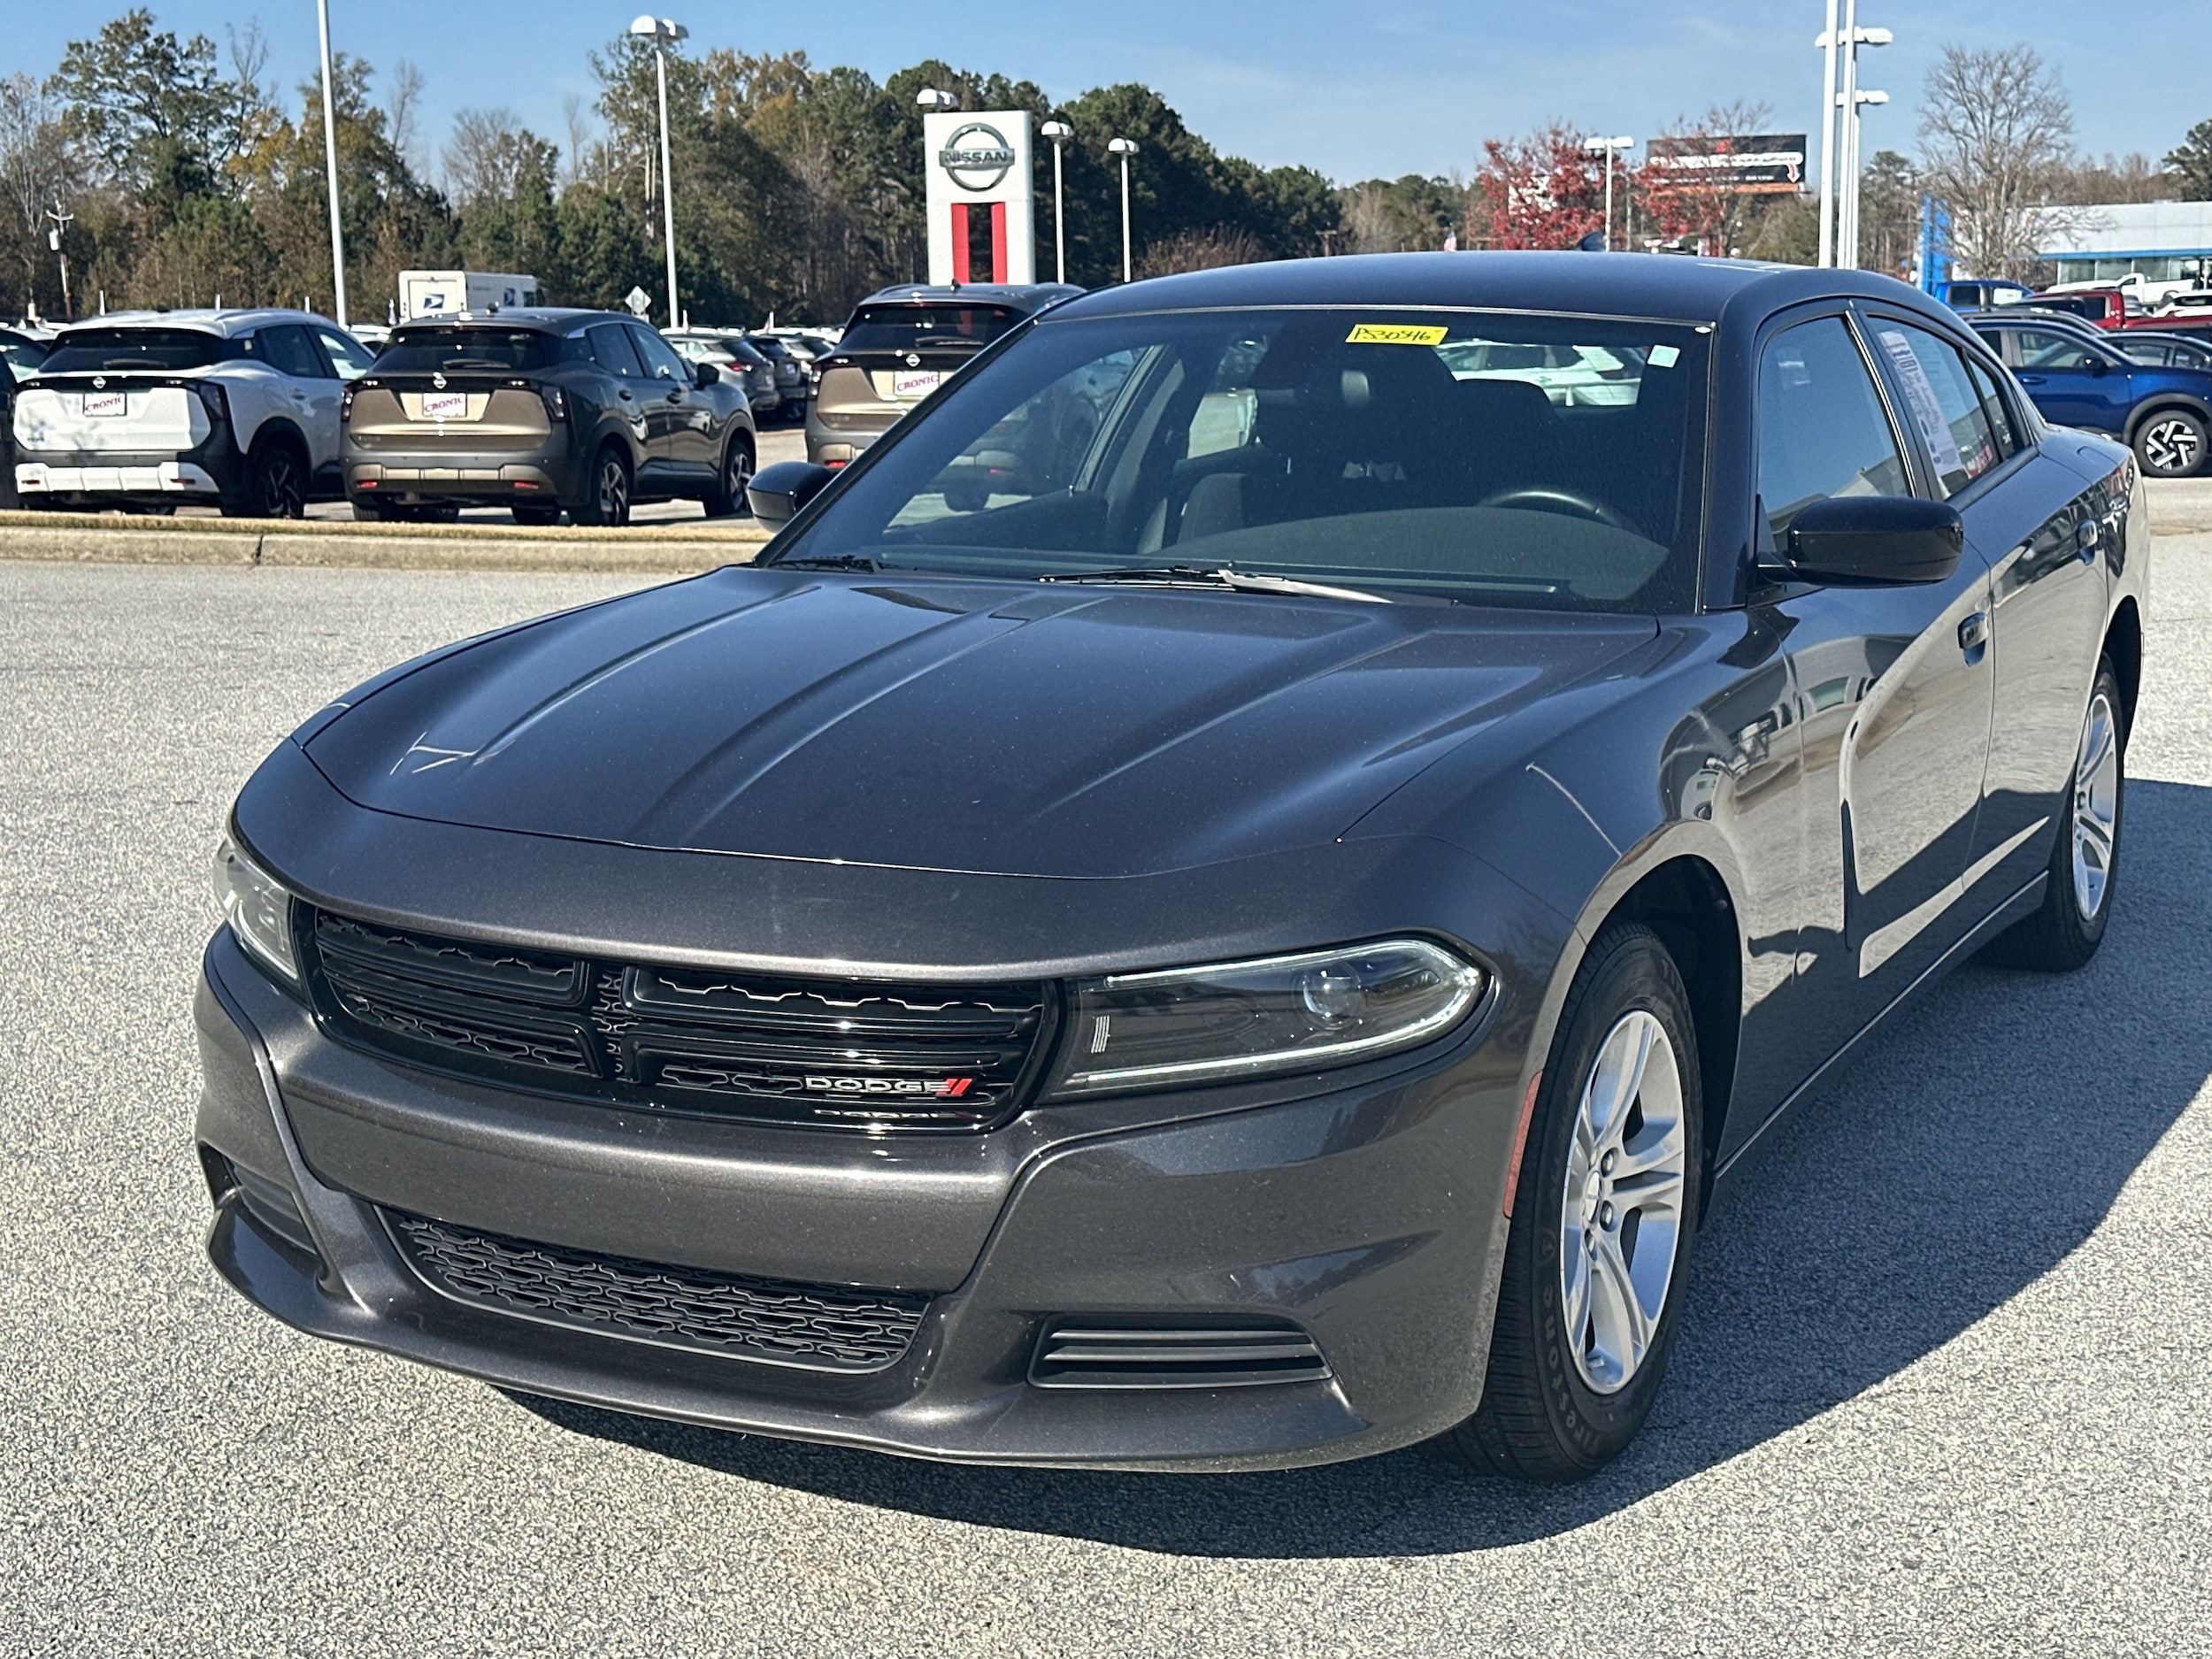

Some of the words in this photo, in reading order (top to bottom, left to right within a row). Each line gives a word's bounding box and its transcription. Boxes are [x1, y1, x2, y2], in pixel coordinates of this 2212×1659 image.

[944, 150, 1007, 163] NISSAN
[896, 375, 938, 391] CRONIC
[424, 396, 464, 412] CRONIC
[805, 1076, 952, 1094] DODGE
